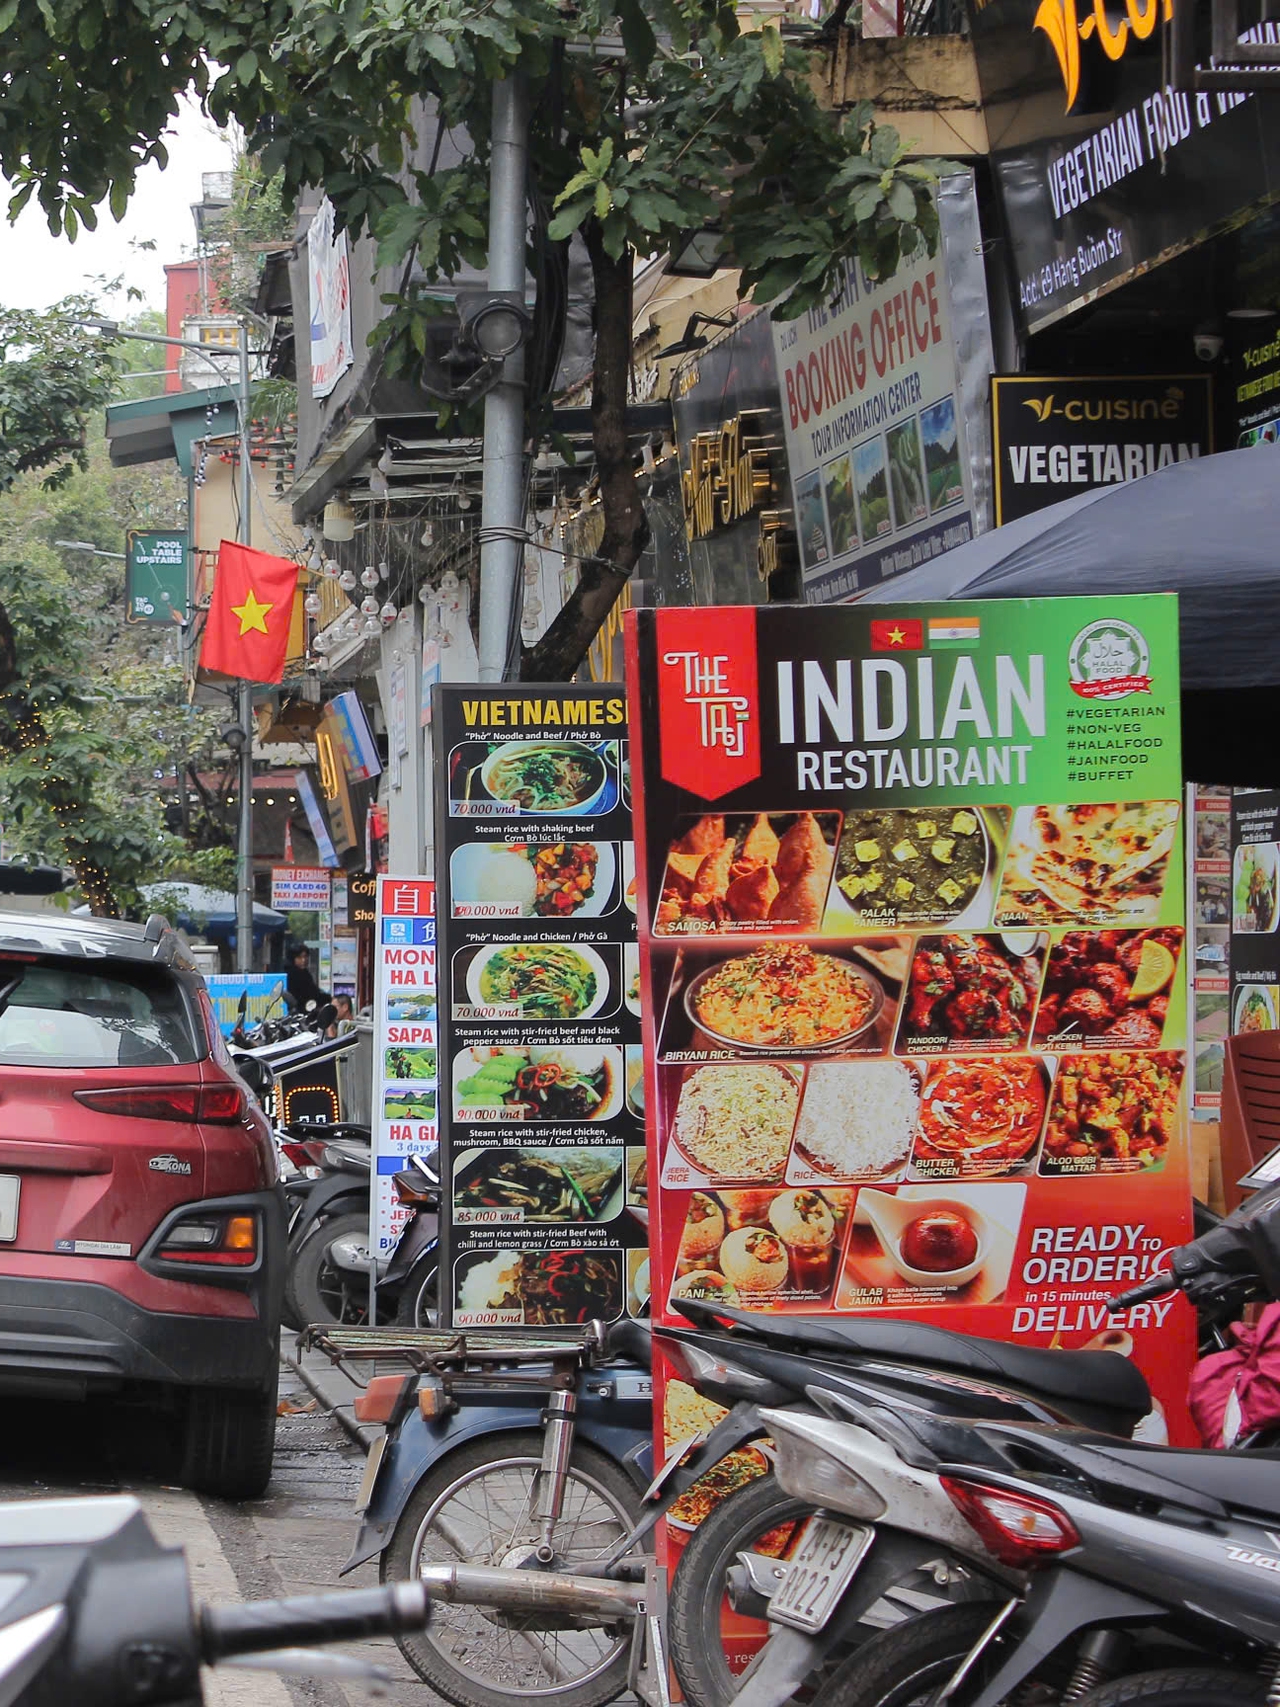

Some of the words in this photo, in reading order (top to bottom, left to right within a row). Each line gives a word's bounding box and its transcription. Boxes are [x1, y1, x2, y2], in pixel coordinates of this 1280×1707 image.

[1047, 107, 1144, 220] VEGETARIAN
[1040, 266, 1054, 297] 69
[784, 322, 867, 431] BOOKING
[870, 271, 942, 379] OFFICE
[811, 424, 832, 459] TOUR
[832, 396, 887, 450] INFORMATION
[888, 371, 922, 416] CENTER
[156, 541, 182, 549] POOL
[152, 548, 182, 556] TABLE
[136, 556, 182, 564] UPSTAIRS
[663, 651, 730, 695] THE
[1102, 681, 1145, 692] CERTIFIED
[777, 654, 1047, 744] INDIAN
[462, 699, 629, 726] VIETNAMES
[1066, 706, 1165, 719] #VEGETARIAN
[1066, 723, 1142, 735] #NON-VEG
[493, 731, 523, 740] Noodle
[525, 731, 541, 739] and
[543, 731, 562, 739] Beef
[564, 731, 568, 741] /
[571, 731, 588, 739] Phở
[590, 731, 601, 739] Bò
[1067, 738, 1163, 751] #HALALFOOD
[1067, 754, 1149, 766] #JAINFOOD
[796, 745, 1033, 791] RESTAURANT
[1067, 770, 1134, 782] #BUFFET
[453, 803, 492, 814] 70.000
[496, 804, 516, 814] vnđ
[542, 824, 573, 834] shaking
[576, 824, 594, 832] beef
[527, 834, 537, 842] Bò
[273, 869, 295, 881] MONEY
[296, 869, 331, 881] EXCHANGE
[293, 883, 314, 891] CARD
[352, 881, 376, 896] Coff
[293, 892, 328, 900] AIRPORT
[273, 901, 300, 909] LAUNDRY
[302, 901, 328, 909] SERVICE
[499, 906, 519, 916] vnđ
[860, 908, 896, 918] PALAK
[1001, 912, 1029, 921] NAAN
[667, 921, 717, 932] SAMOSA
[853, 918, 896, 927] PANEER
[493, 933, 521, 941] Noodle
[572, 932, 577, 941] /
[579, 932, 595, 940] Phở
[597, 932, 607, 941] Gà
[385, 949, 435, 965] MON
[390, 970, 417, 985] HA
[456, 1007, 495, 1018] 70.000
[498, 1008, 519, 1018] vnđ
[388, 1027, 433, 1043] SAPA
[522, 1027, 557, 1035] stir-fried
[560, 1027, 578, 1035] beef
[463, 1038, 493, 1047] pepper
[520, 1037, 524, 1045] /
[549, 1036, 560, 1044] Bò
[562, 1035, 575, 1044] sốt
[577, 1035, 594, 1043] tiêu
[907, 1036, 948, 1045] TANDOORI
[1047, 1033, 1083, 1042] CHICKEN
[907, 1045, 943, 1054] CHICKEN
[664, 1051, 707, 1061] BIRYANI
[710, 1050, 736, 1060] RICE
[457, 1109, 496, 1120] 90.000
[499, 1109, 520, 1120] vnđ
[389, 1125, 415, 1141] HA
[515, 1128, 534, 1136] with
[536, 1128, 572, 1136] stir-fried
[574, 1128, 607, 1137] chicken,
[454, 1136, 501, 1146] mushroom,
[503, 1138, 521, 1146] BBQ
[549, 1137, 553, 1146] /
[591, 1136, 603, 1144] sốt
[397, 1143, 403, 1151] 3
[407, 1143, 431, 1153] days
[916, 1159, 954, 1167] BUTTER
[1046, 1157, 1072, 1165] ALOO
[167, 1162, 192, 1172] KONA
[916, 1168, 960, 1176] CHICKEN
[666, 1174, 689, 1182] RICE
[793, 1171, 817, 1179] RICE
[457, 1211, 497, 1222] 85.000
[500, 1211, 521, 1222] vnđ
[533, 1229, 567, 1237] stir-fried
[589, 1229, 606, 1237] with
[1030, 1224, 1146, 1253] READY
[1140, 1238, 1162, 1251] TO
[457, 1240, 477, 1248] chilli
[478, 1240, 493, 1248] and
[495, 1239, 520, 1248] lemon
[522, 1241, 542, 1249] grass
[543, 1239, 548, 1248] /
[571, 1239, 581, 1247] Bò
[1022, 1255, 1149, 1284] ORDER!
[678, 1290, 705, 1299] PANI
[849, 1287, 883, 1297] GULAB
[1025, 1292, 1037, 1303] in
[1042, 1291, 1057, 1302] 15
[1059, 1290, 1111, 1301] minutes
[849, 1296, 883, 1305] JAMUN
[458, 1313, 498, 1325] 90.000
[500, 1313, 521, 1323] vnđ
[1011, 1303, 1174, 1333] DELIVERY
[799, 1522, 854, 1571] 29-P3
